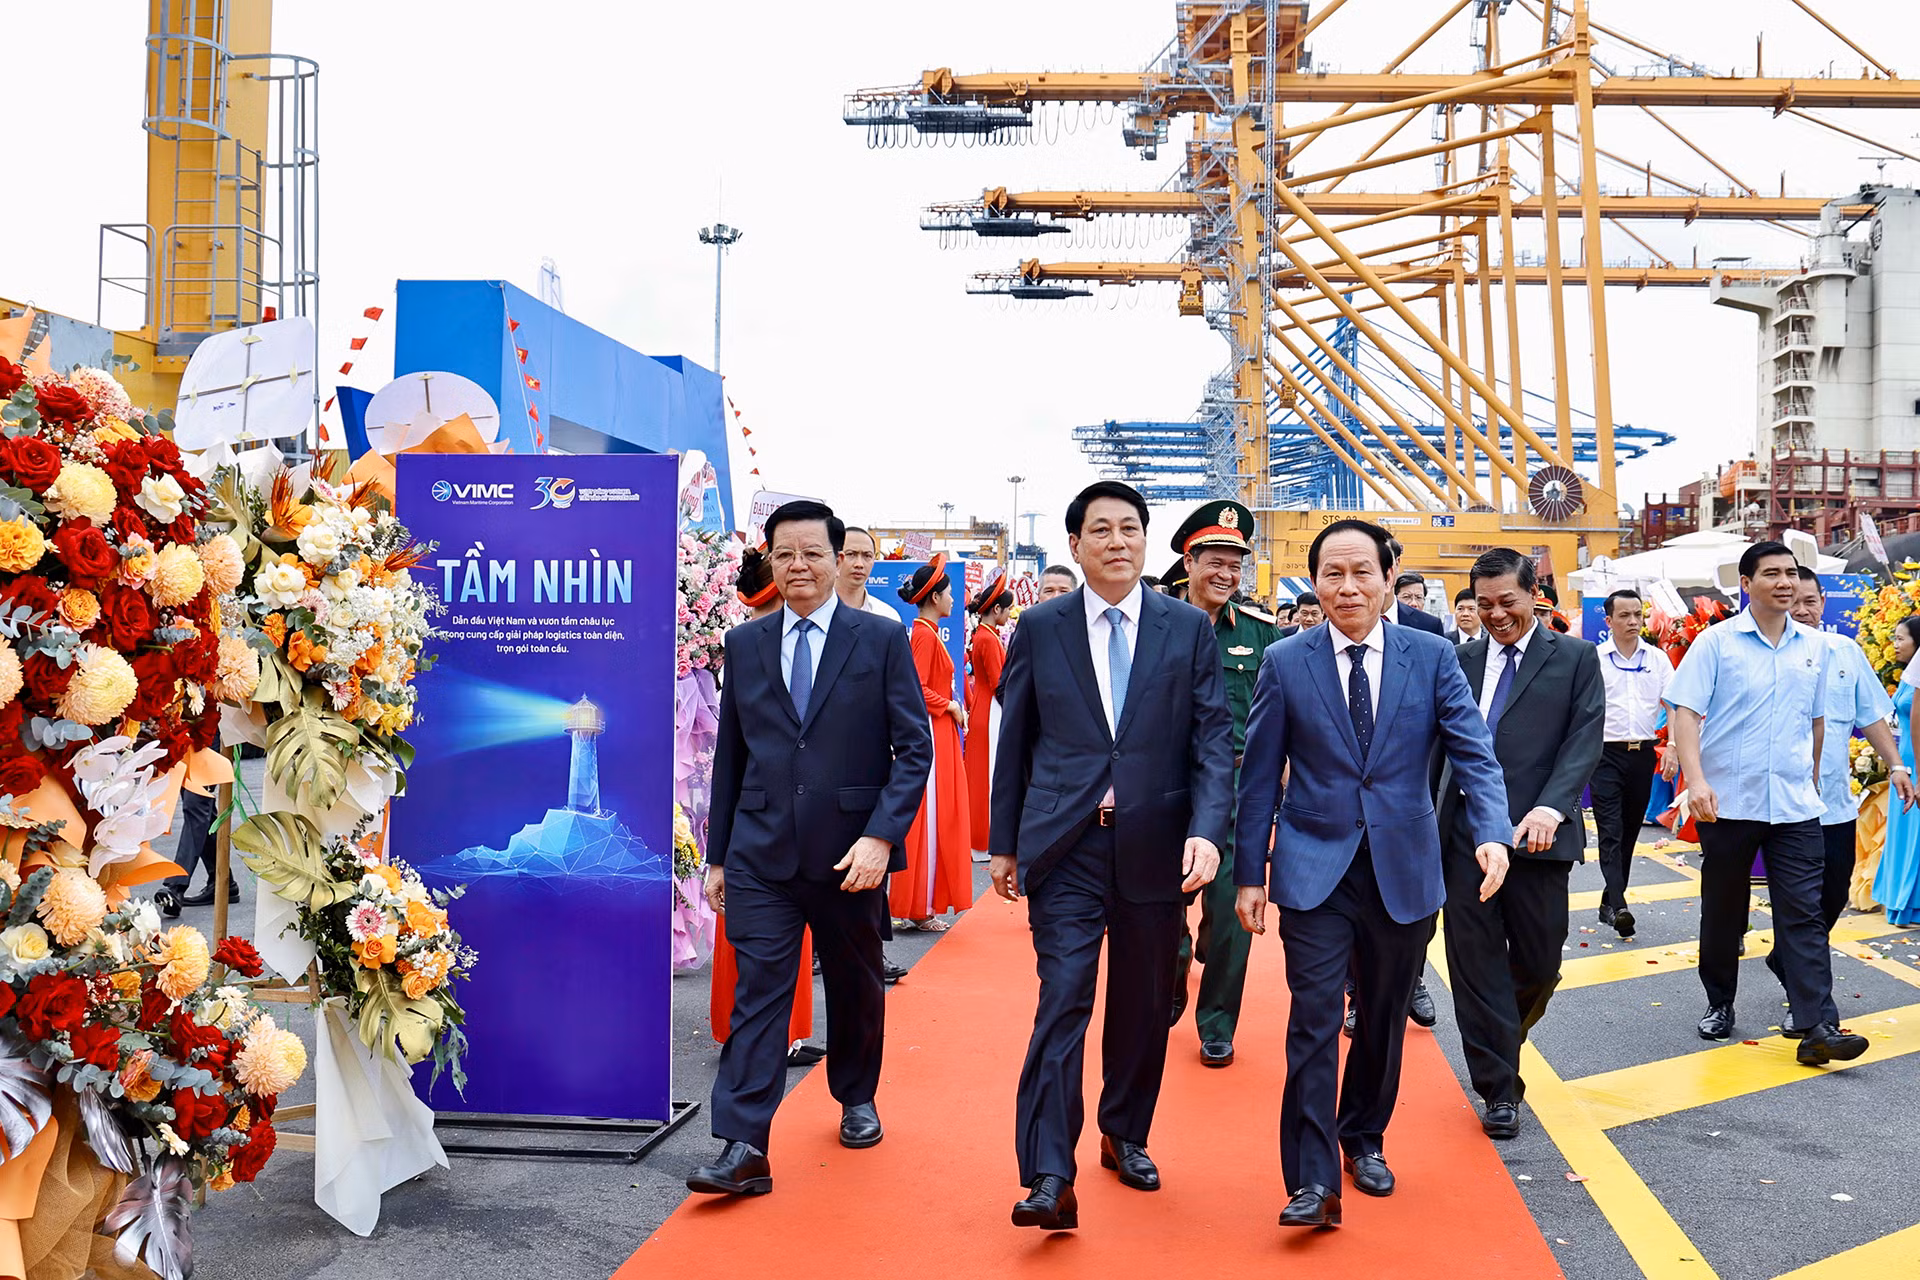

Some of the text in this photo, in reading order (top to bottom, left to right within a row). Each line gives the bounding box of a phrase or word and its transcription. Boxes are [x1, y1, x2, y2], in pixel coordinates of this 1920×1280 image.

[436, 541, 633, 604] TẦM NHÌN
[865, 576, 889, 584] IMC
[452, 615, 469, 625] Dẫn
[487, 616, 505, 627] Việt
[506, 616, 526, 625] Nam
[527, 617, 538, 626] và
[538, 617, 560, 626] vươn
[579, 617, 601, 626] châu
[601, 617, 615, 627] lục
[466, 631, 487, 641] cung
[488, 630, 505, 641] cấp
[505, 630, 522, 641] giải
[522, 630, 544, 642] pháp
[545, 630, 582, 642] logistics
[583, 631, 603, 640] toàn
[604, 630, 625, 642] diện,
[496, 644, 514, 655] trọn
[515, 644, 529, 655] gói
[530, 644, 550, 653] toàn
